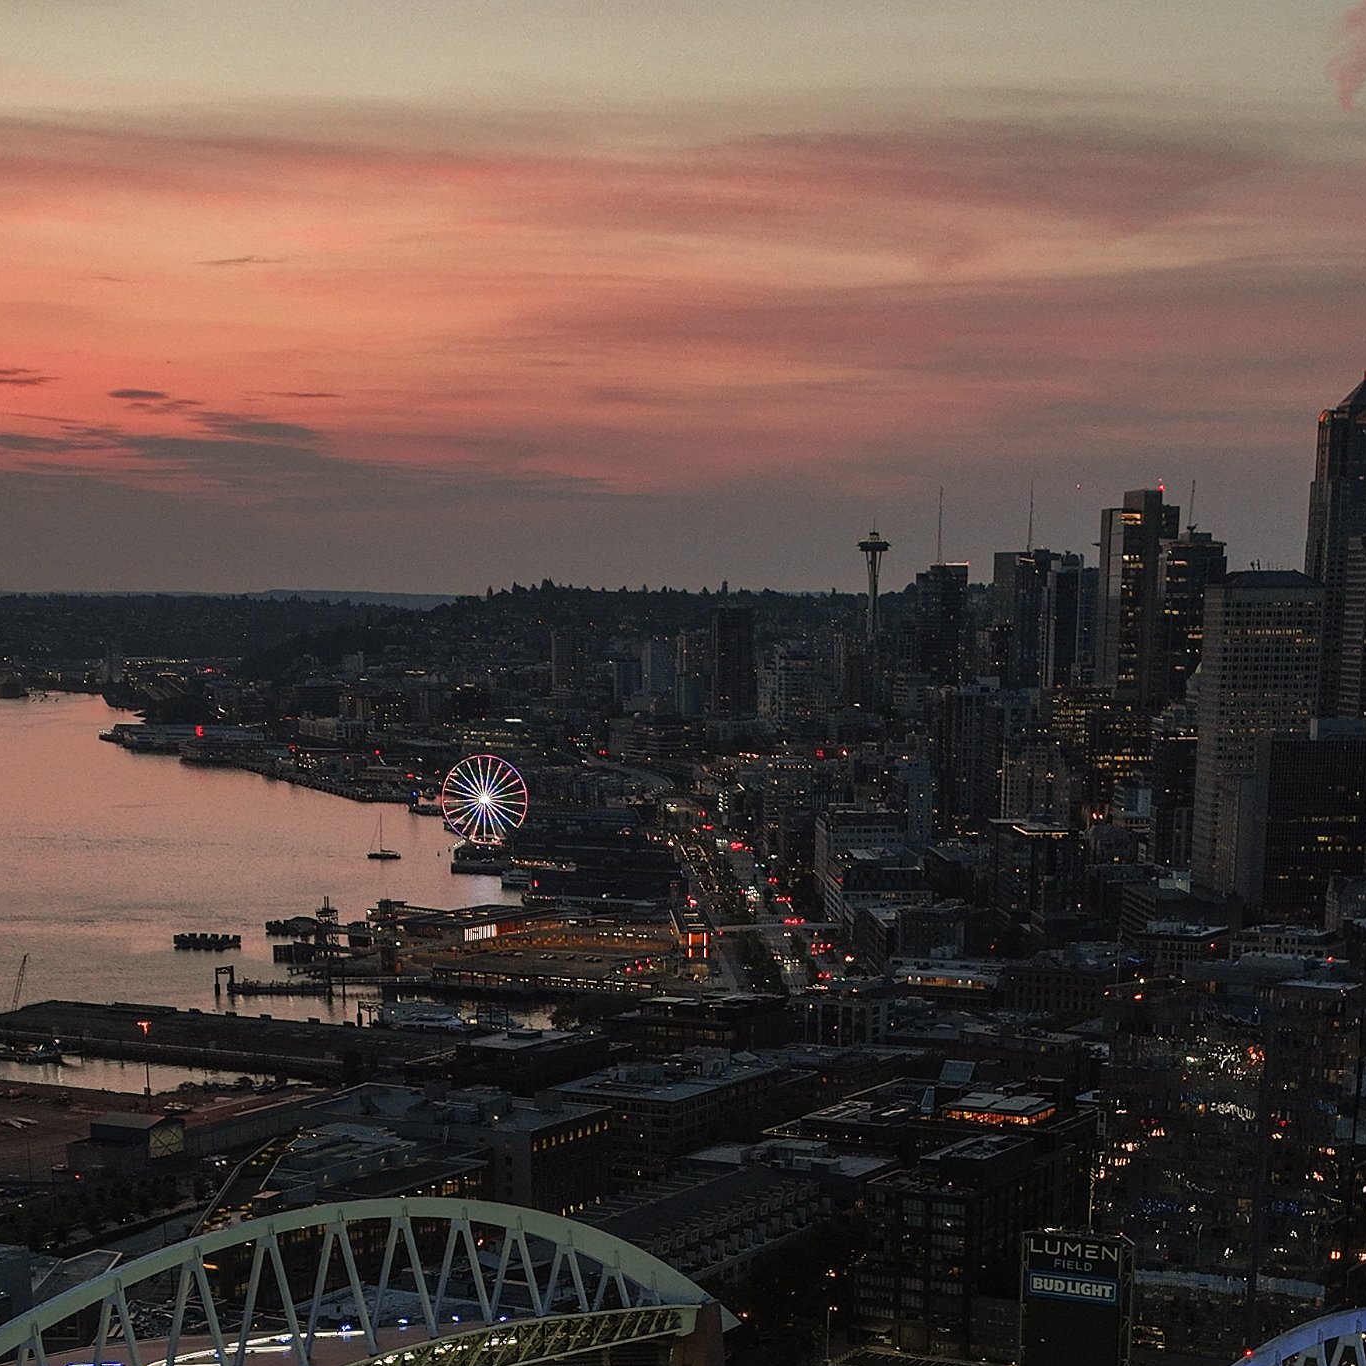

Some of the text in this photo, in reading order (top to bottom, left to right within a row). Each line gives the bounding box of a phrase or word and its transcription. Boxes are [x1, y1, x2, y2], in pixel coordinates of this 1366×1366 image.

[1030, 1238, 1119, 1263] LUMEN
[1053, 1258, 1093, 1272] FIELD
[1032, 1277, 1114, 1299] BUD LIGHT
